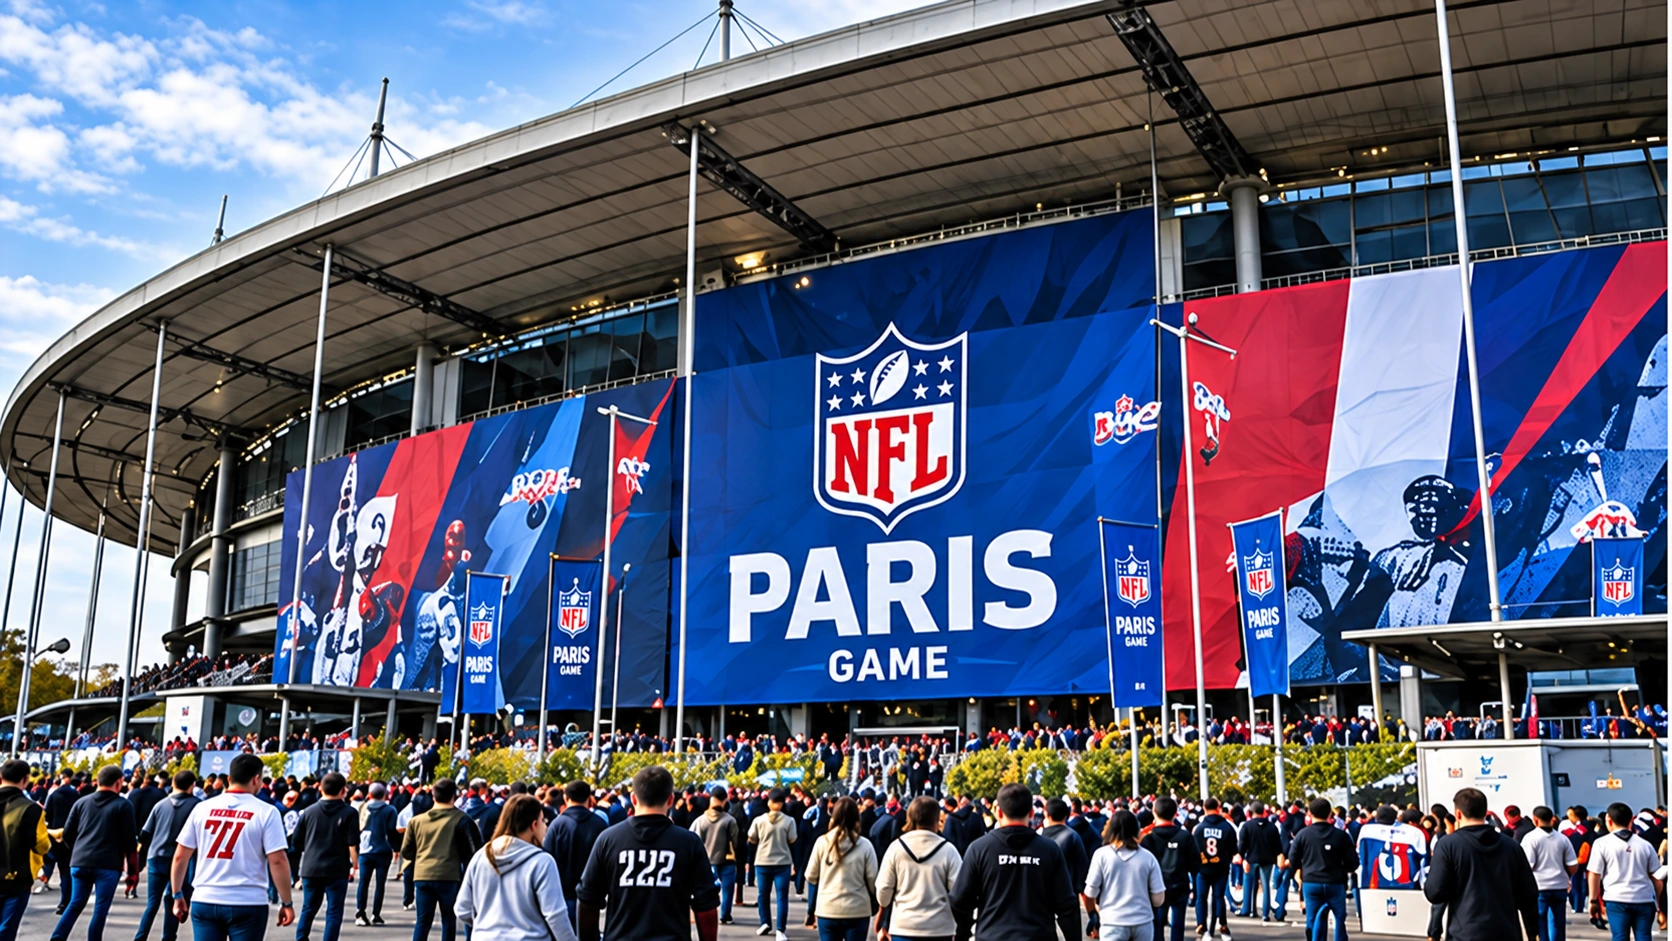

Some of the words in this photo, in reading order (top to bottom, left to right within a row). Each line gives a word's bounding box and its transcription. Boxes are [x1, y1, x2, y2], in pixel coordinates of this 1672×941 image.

[830, 411, 948, 505] NFL
[728, 529, 1058, 643] PARIS
[1120, 577, 1148, 600] NFL
[1249, 570, 1272, 593] NFL
[1606, 582, 1631, 600] NFL
[561, 608, 587, 630] NFL
[1115, 616, 1156, 635] PARIS
[1247, 606, 1280, 629] PARIS
[471, 622, 491, 642] NFL
[1125, 636, 1148, 647] GAME
[1255, 627, 1274, 640] GAME
[465, 656, 493, 673] PARIS
[553, 646, 590, 664] PARIS
[828, 646, 949, 682] GAME
[560, 665, 582, 675] GAME
[204, 819, 245, 859] 71
[1206, 837, 1217, 856] 8
[619, 849, 676, 887] 222
